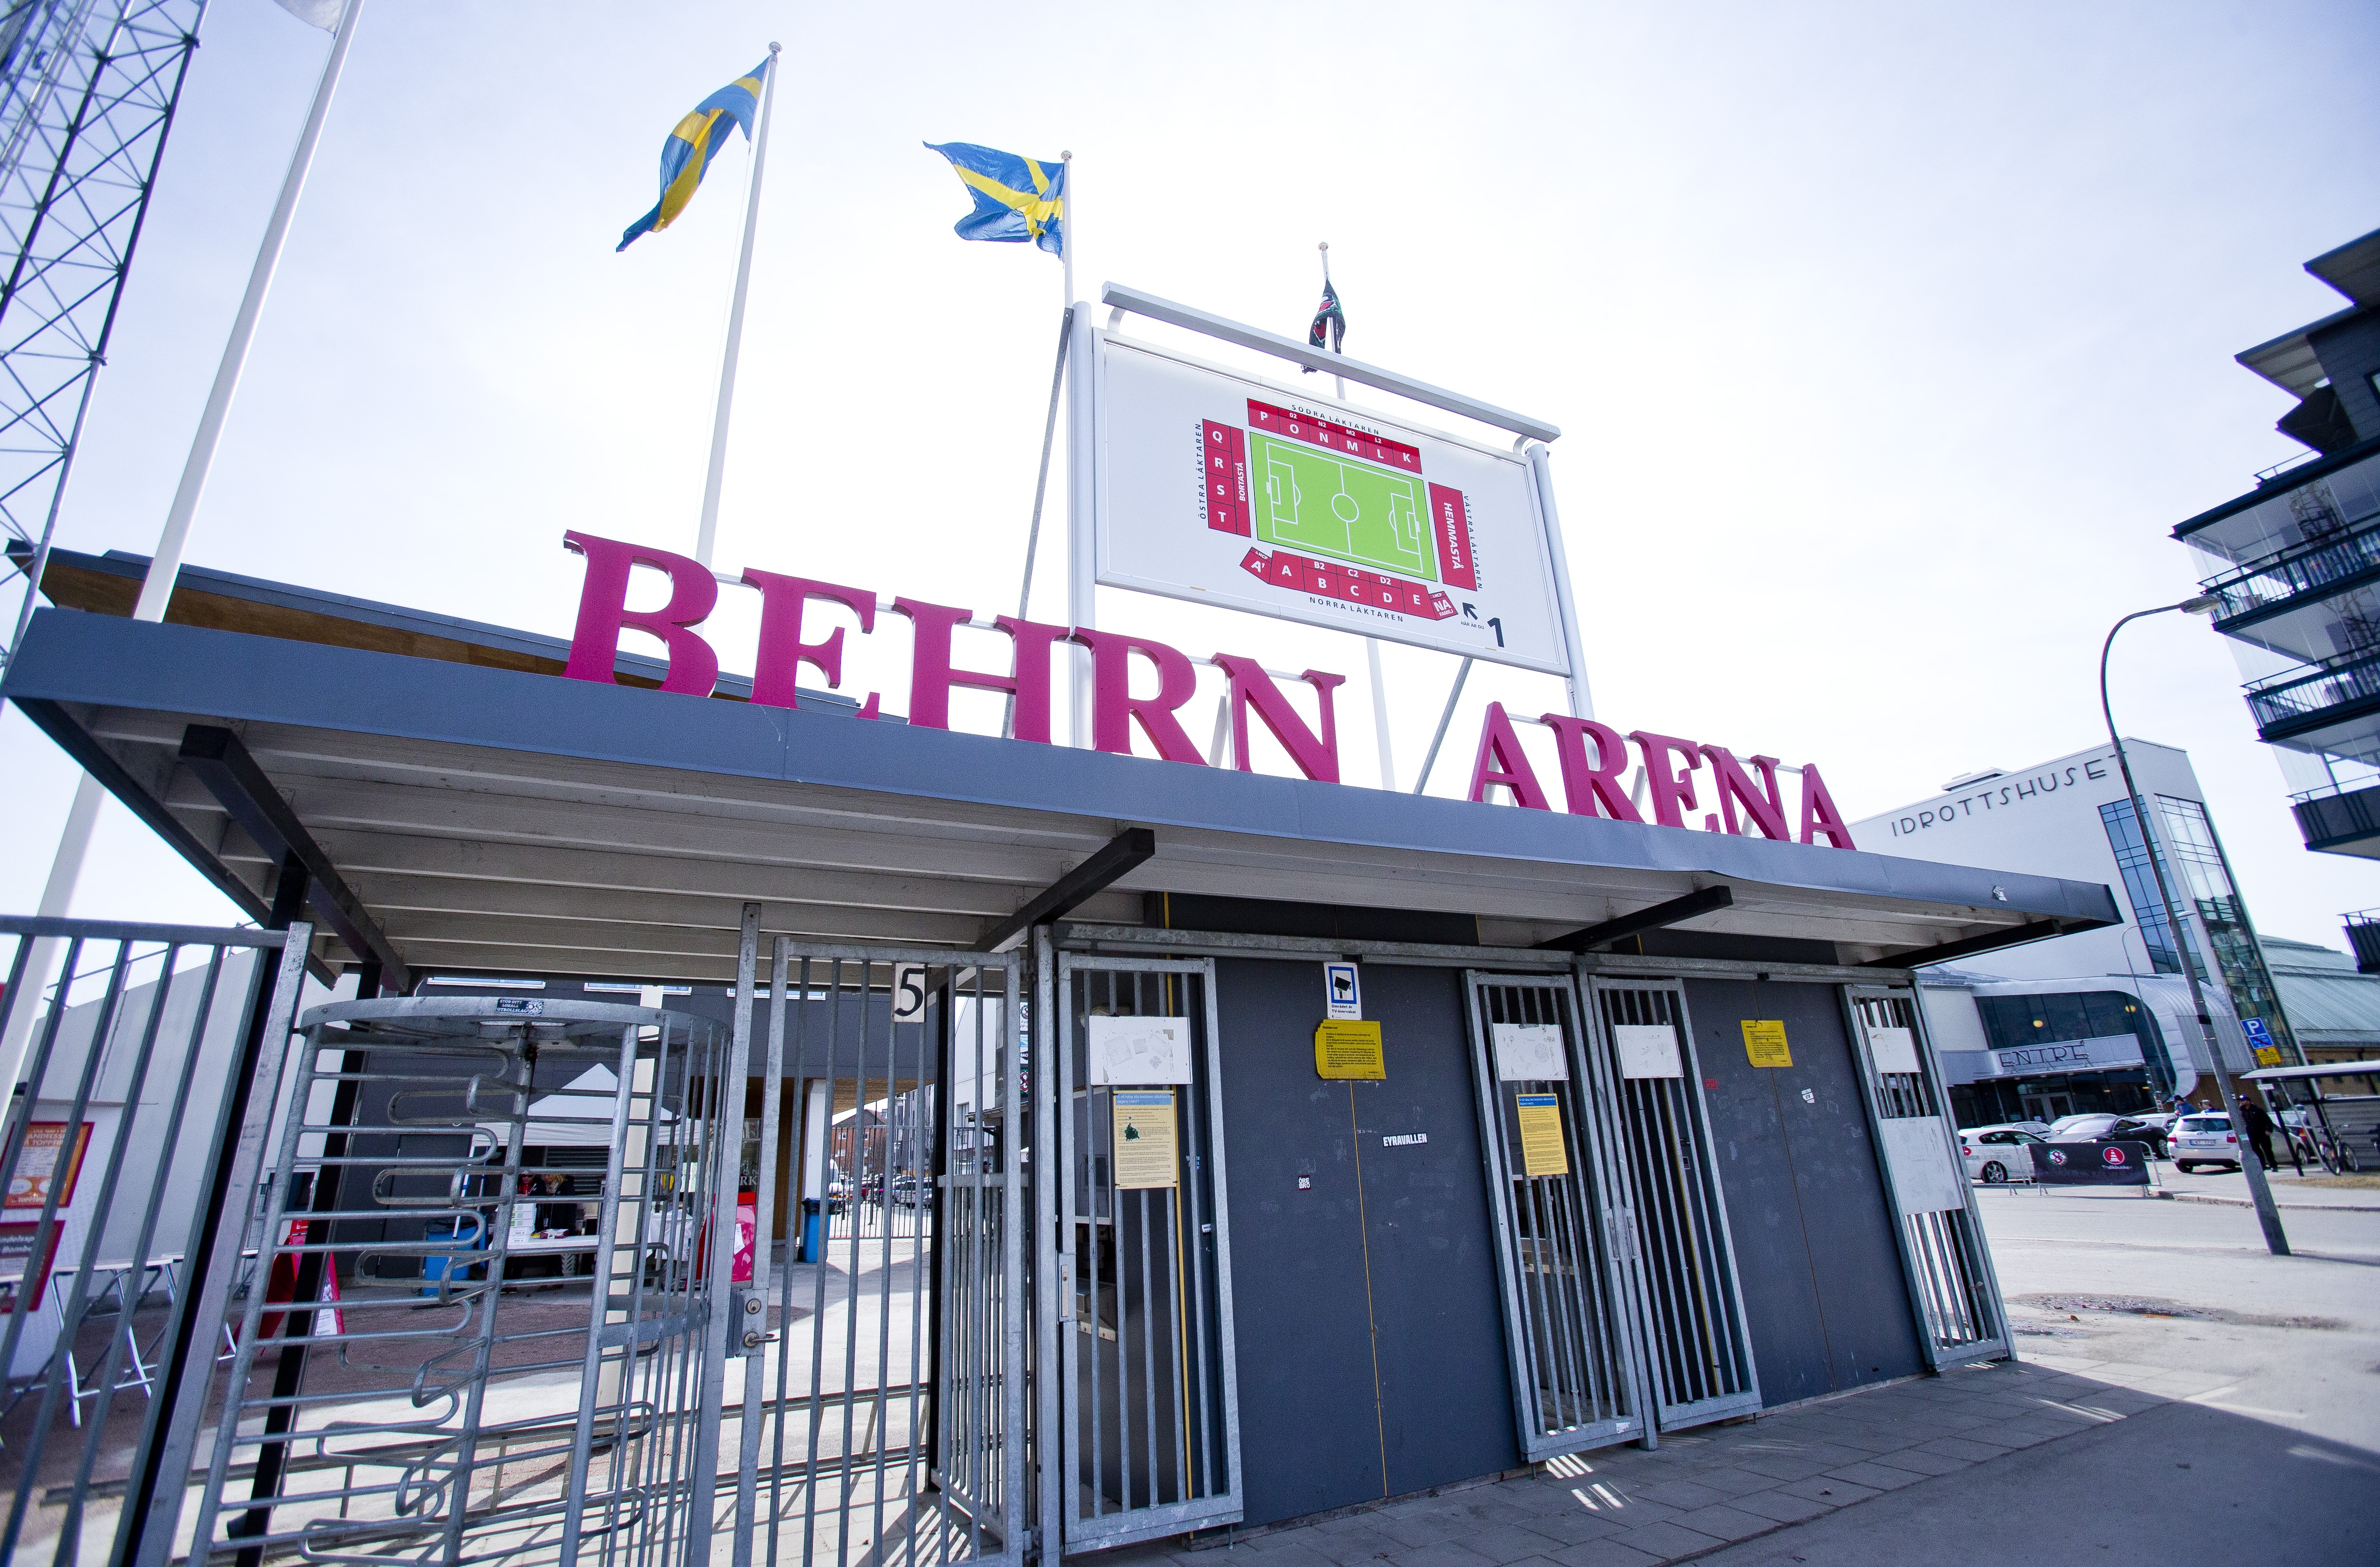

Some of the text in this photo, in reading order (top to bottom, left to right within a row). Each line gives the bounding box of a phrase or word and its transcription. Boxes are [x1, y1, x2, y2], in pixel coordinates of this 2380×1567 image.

[1260, 411, 1268, 421] P
[1292, 404, 1379, 435] SÖDRA LÄKTAREN
[1212, 431, 1223, 444] Q
[1319, 432, 1328, 443] N
[1195, 423, 1204, 480] LÄKTAREN
[1346, 440, 1358, 452] M
[1377, 449, 1384, 459] L
[1403, 453, 1411, 463] K
[1215, 457, 1224, 468] R
[1235, 462, 1246, 501] BORTASTÅ
[1216, 485, 1225, 496] S
[1218, 511, 1226, 522] T
[1444, 502, 1464, 570] HEMMASTÅ
[1464, 496, 1483, 589] VÄSTRA LÄKTAREN
[1281, 565, 1292, 577] A
[1314, 561, 1325, 570] B2
[1348, 569, 1359, 578] C2
[1318, 577, 1327, 589] B
[1380, 576, 1391, 585] D2
[1350, 585, 1359, 596] C
[1383, 592, 1392, 603] D
[1413, 594, 1421, 605] E
[1310, 597, 1403, 622] NORRA LÄKTAREN
[1433, 600, 1452, 612] NA
[1487, 617, 1505, 647] 1
[560, 529, 1858, 851] BEHRN ARENA
[894, 967, 925, 1017] 5
[2246, 1020, 2260, 1034] P
[1998, 1040, 2089, 1067] ENTRÉ
[1383, 1133, 1428, 1147] EYRAVALLEN
